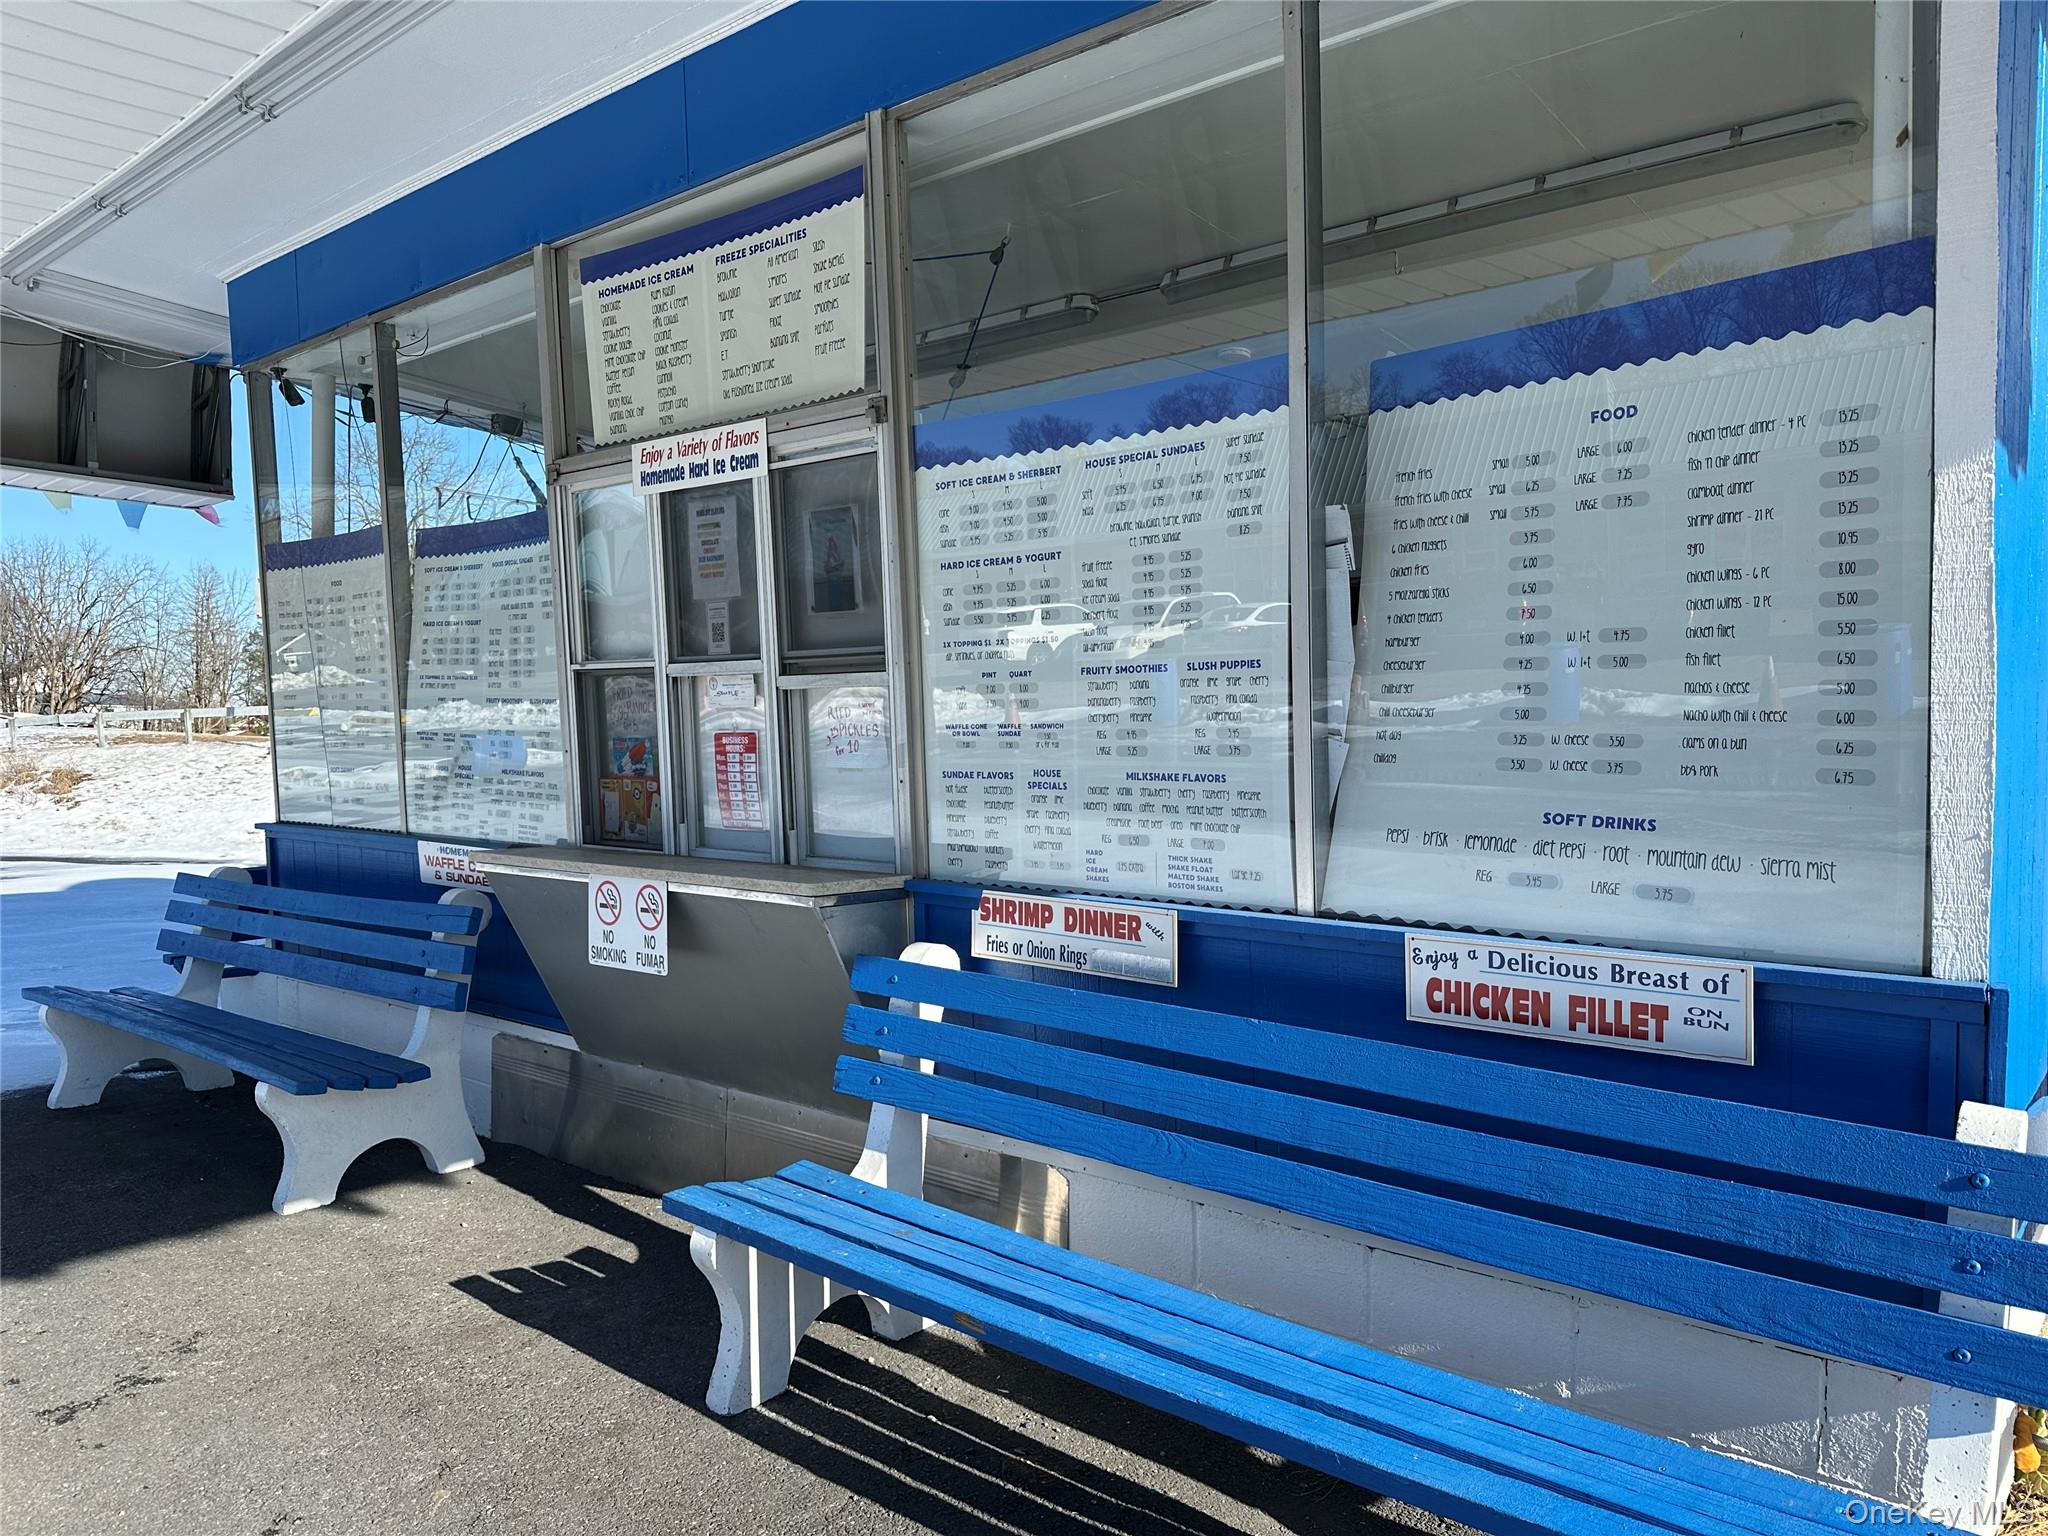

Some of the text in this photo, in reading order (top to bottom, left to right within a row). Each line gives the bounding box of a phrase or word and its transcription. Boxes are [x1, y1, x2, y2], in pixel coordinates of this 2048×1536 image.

[715, 228, 807, 266] FREEZE SPECIALITIES
[598, 264, 694, 299] HOMEMADE ICE CREAM
[1591, 404, 1639, 424] FOOD
[641, 430, 759, 468] Enjoy a Variety of Flavors
[1085, 442, 1205, 469] HOUSE SPECIAL SUNDAES
[641, 452, 759, 487] Homemade Hard Ice Cream
[936, 465, 1061, 490] SOFT ICE CREAM & SHERBERT
[1687, 533, 1858, 556] gyro 10.95
[940, 552, 1061, 571] HARD ICE CREAM & YOGURT
[1187, 659, 1261, 671] SLUSH PUPPIES
[1686, 653, 1700, 665] fish
[1703, 652, 1722, 666] fillet
[1009, 670, 1032, 678] QUART
[1081, 663, 1168, 676] FRUITY SMOOTHIES
[828, 706, 851, 720] RIED
[839, 722, 879, 737] PICKLES
[847, 740, 859, 753] 10
[1708, 738, 1719, 749] on
[1722, 739, 1727, 749] a
[1731, 738, 1747, 750] bun
[942, 771, 1014, 780] SUNDAE FLAVORS
[1033, 769, 1061, 778] HOUSE
[1126, 772, 1226, 783] MILKSHAKE FLAVORS
[1027, 781, 1067, 790] SPECIALS
[1542, 812, 1656, 832] SOFT DRINKS
[440, 846, 468, 856] HOMEM
[1423, 831, 1448, 847] brisk
[1464, 834, 1517, 853] lemonade
[1532, 840, 1556, 859] diet
[1603, 845, 1630, 865] root
[1647, 848, 1707, 870] mountain
[1712, 854, 1741, 873] dew
[1760, 857, 1801, 878] sierra
[1806, 860, 1836, 883] mist
[424, 855, 464, 871] WAFFLE
[1086, 866, 1108, 874] CREAM
[435, 871, 442, 880] &
[1086, 875, 1109, 883] SHAKES
[1168, 873, 1219, 883] MALTED SHAKE
[1476, 869, 1492, 882] REG
[1197, 884, 1223, 892] SHAKES
[1591, 881, 1621, 895] LARGE
[980, 896, 1164, 942] SHRIMP DINNER with
[603, 930, 614, 944] NO
[644, 935, 656, 950] NO
[591, 946, 626, 963] SMOKING
[987, 935, 1088, 969] Fries or Onion Rings
[637, 952, 664, 969] FUMAR
[1413, 947, 1730, 994] Enjoy a Delicious Breast of
[1426, 977, 1669, 1042] CHICKEN FILLET
[1688, 1007, 1723, 1019] ON
[1683, 1017, 1729, 1031] BUN
